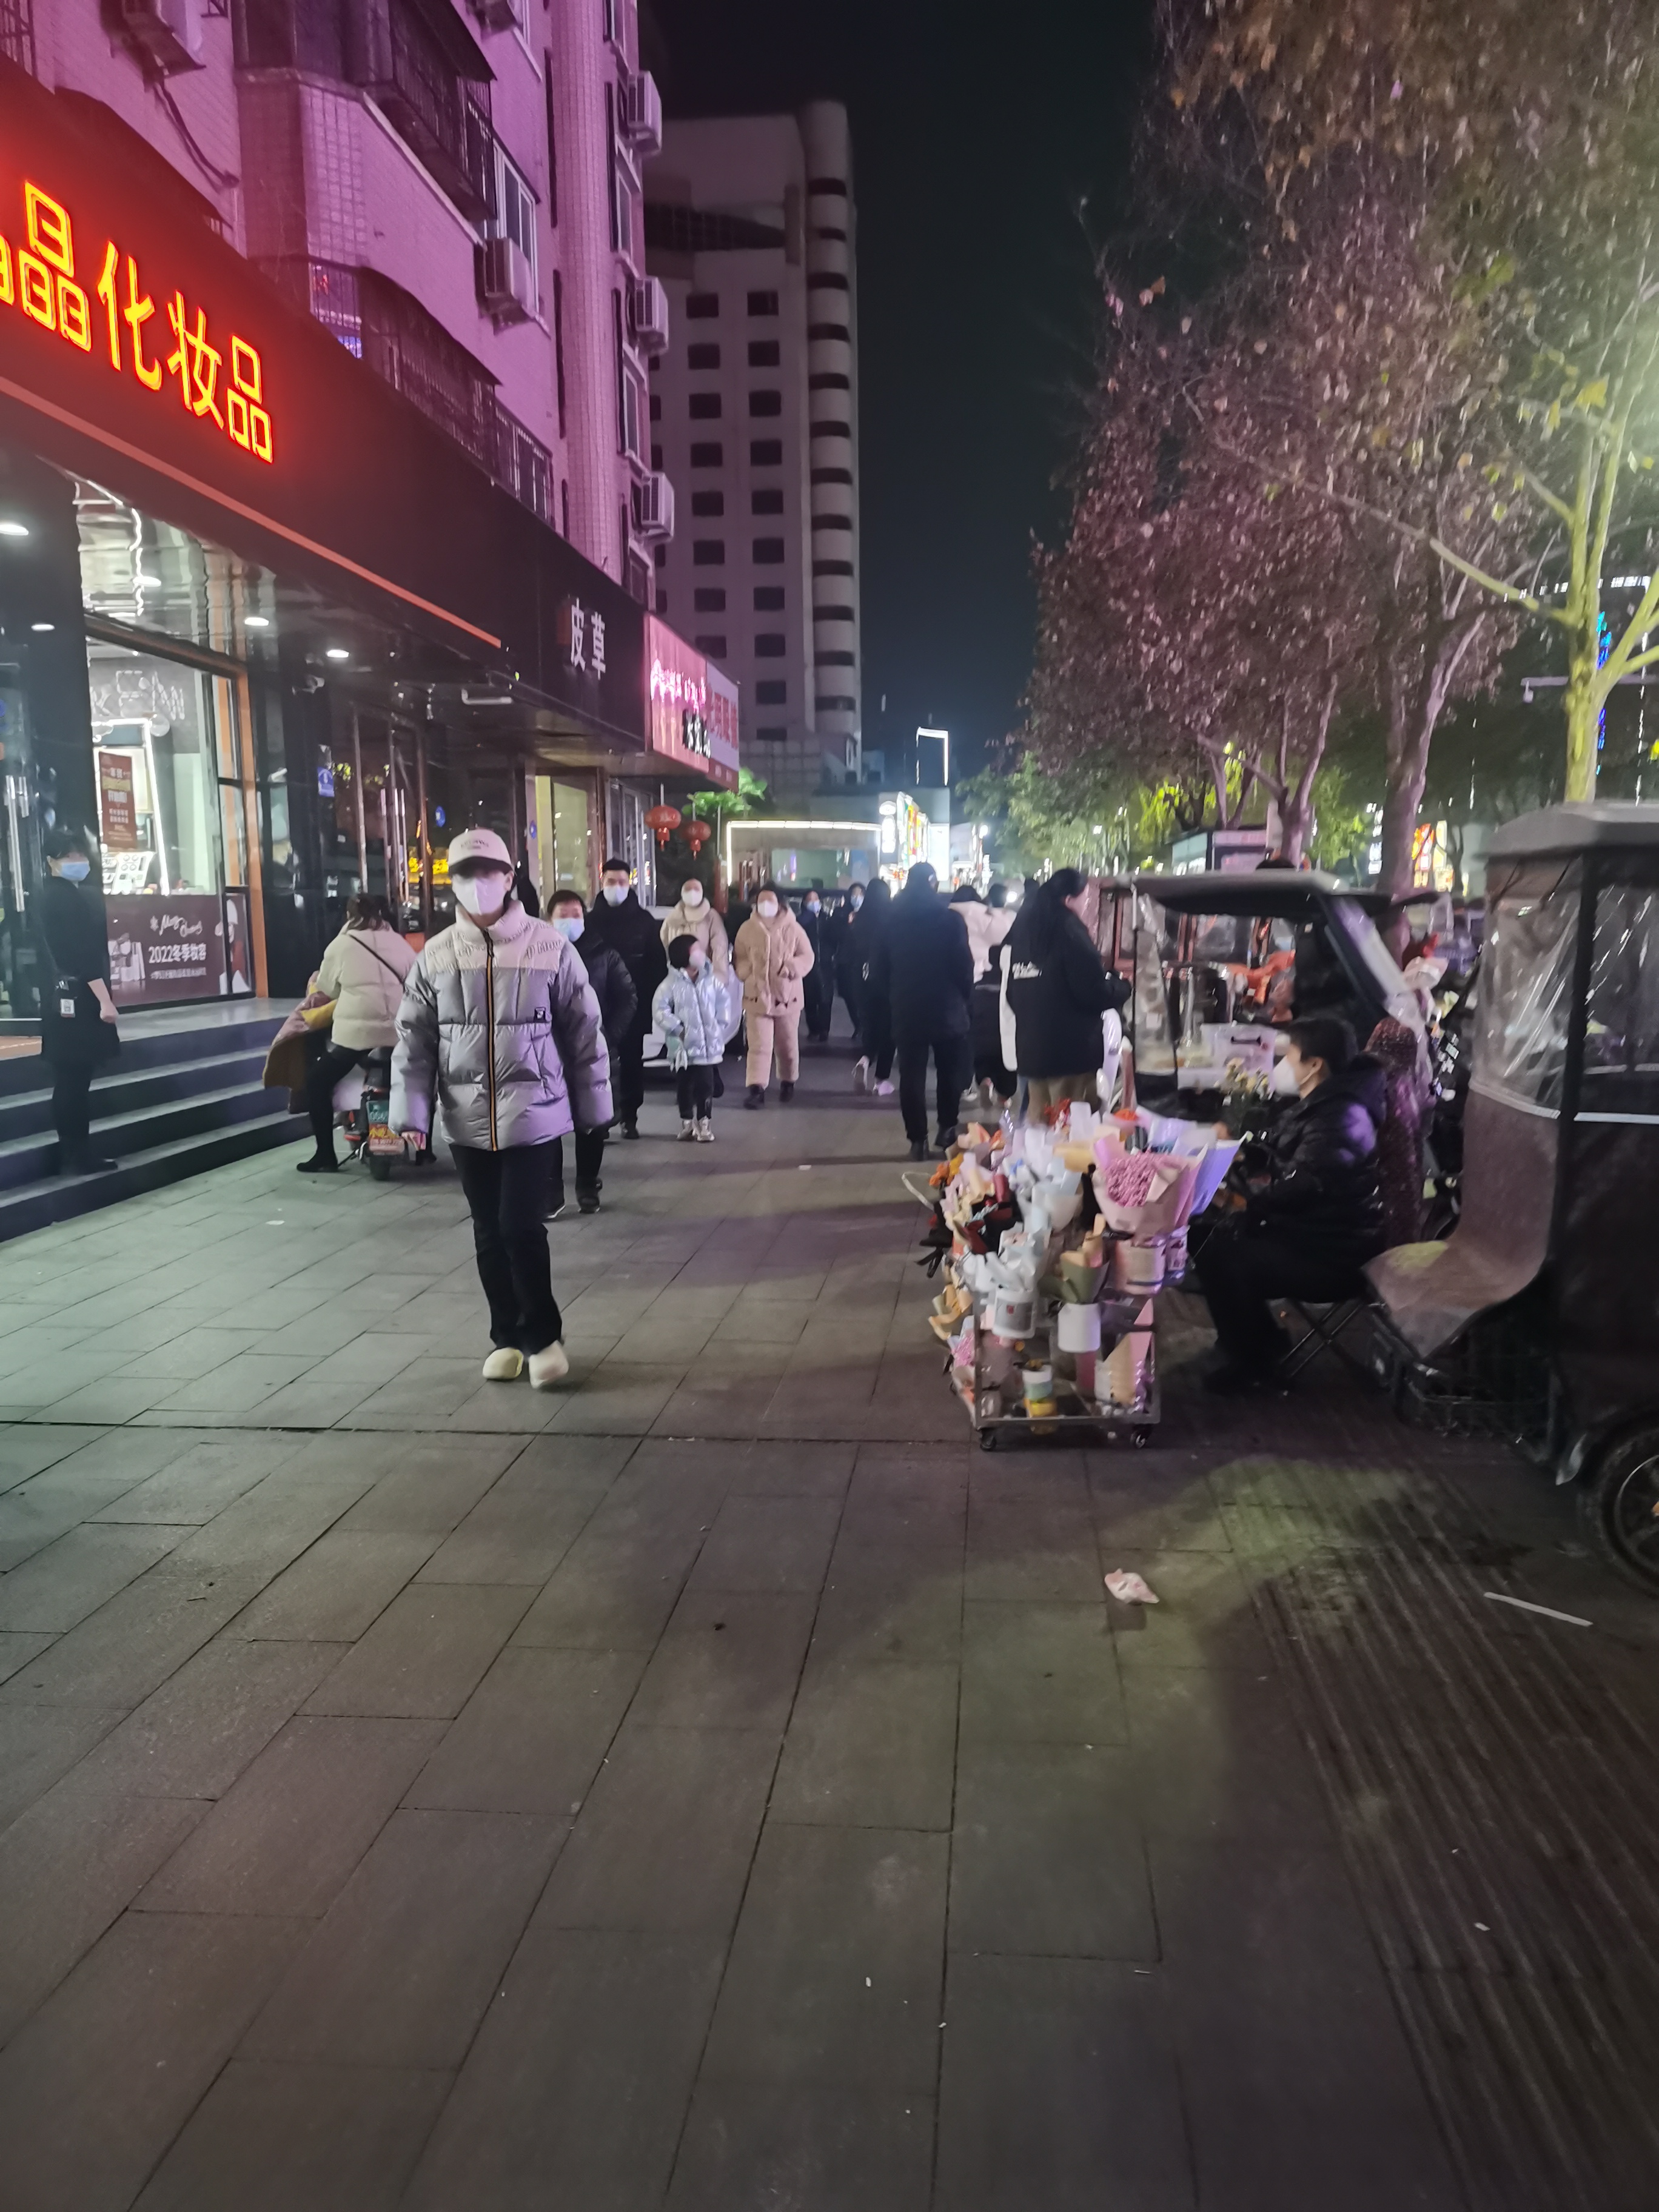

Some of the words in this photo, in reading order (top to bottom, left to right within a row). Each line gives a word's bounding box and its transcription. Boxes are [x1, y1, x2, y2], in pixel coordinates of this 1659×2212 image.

[0, 181, 273, 463] 晶化妆品
[571, 597, 606, 680] 皮草
